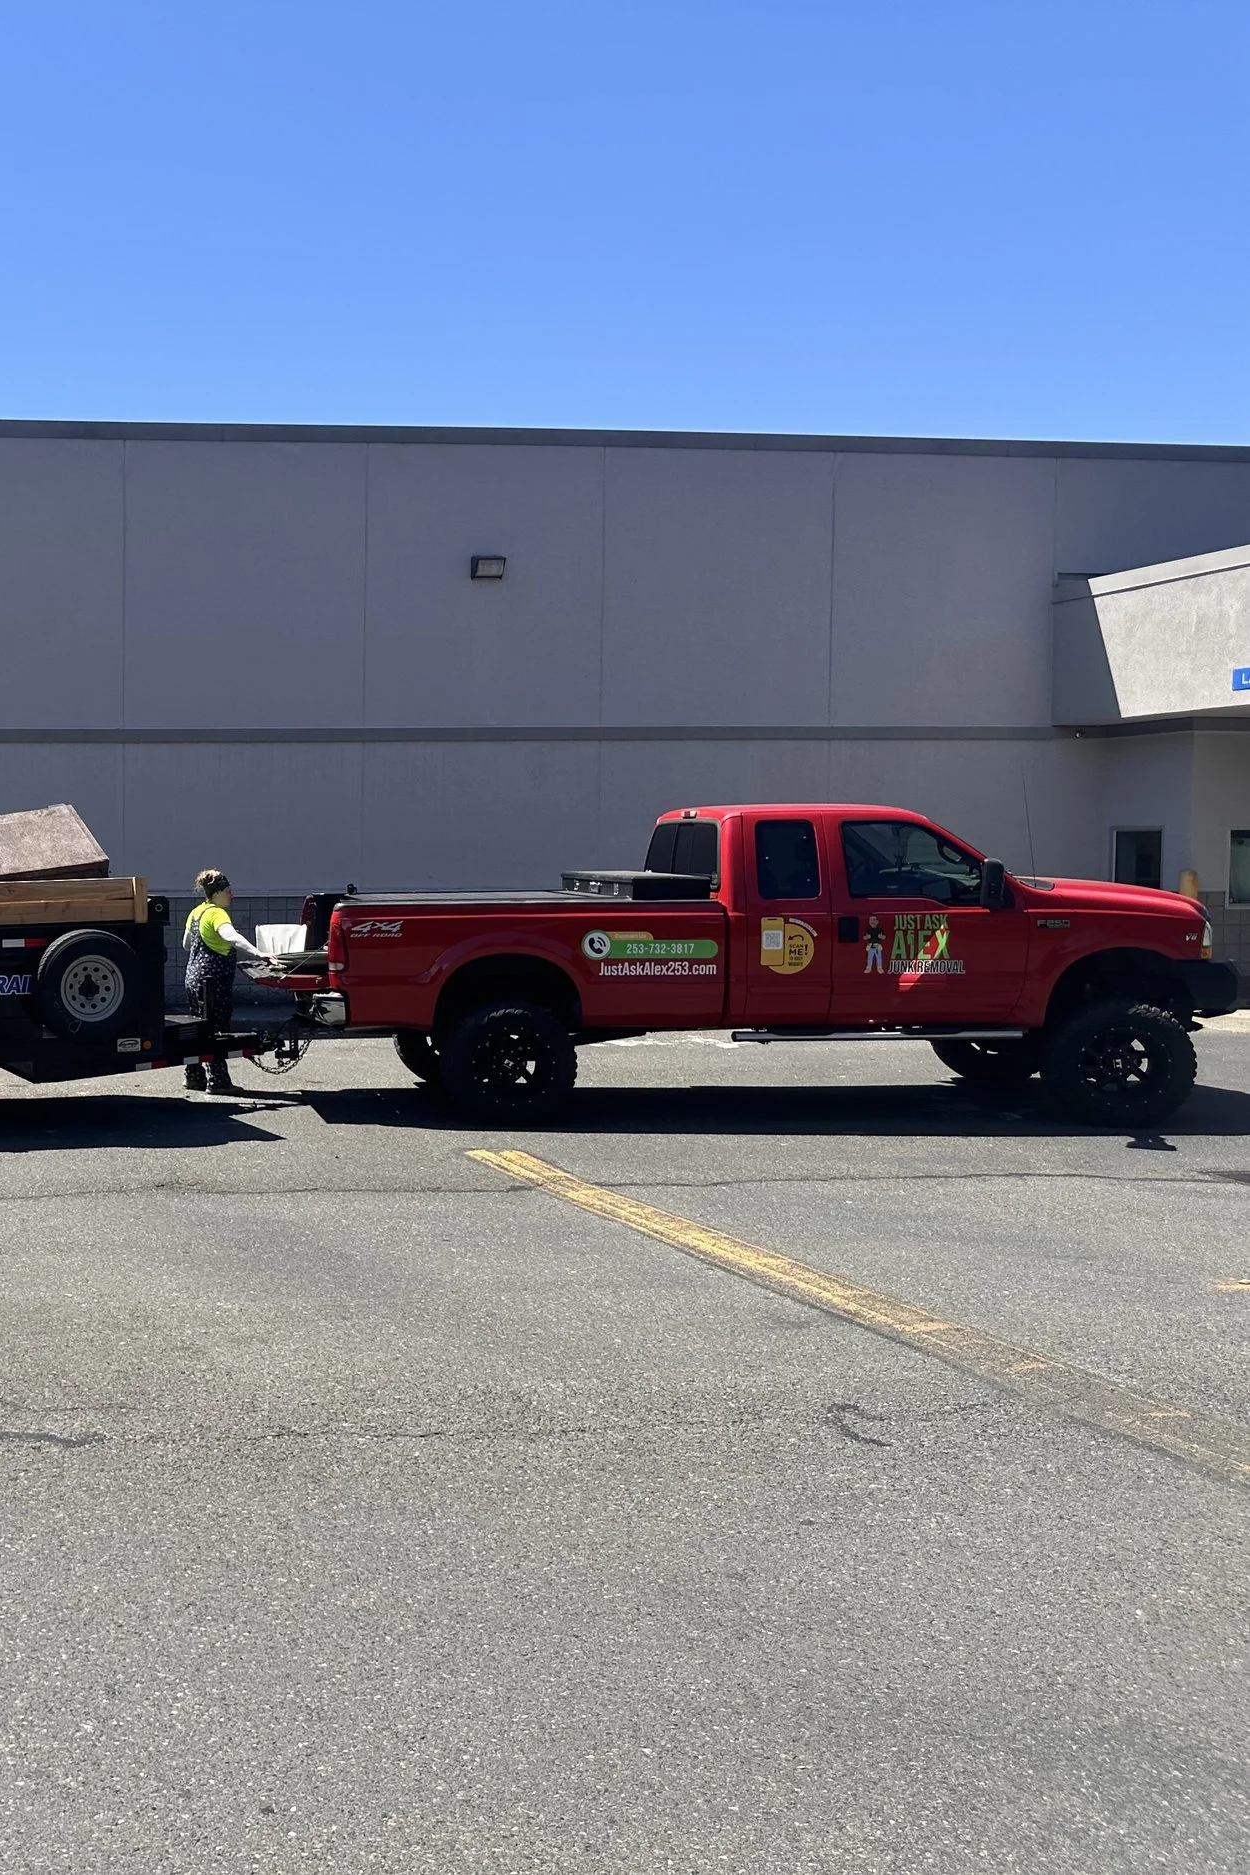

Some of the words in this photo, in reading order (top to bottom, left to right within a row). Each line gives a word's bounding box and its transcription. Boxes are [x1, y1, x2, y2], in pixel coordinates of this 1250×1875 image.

[894, 914, 921, 930] JUST
[924, 914, 949, 930] ASK
[626, 943, 694, 954] 253-732-3817
[599, 962, 717, 976] JustAskAlex253.com
[888, 960, 915, 974] JUNK
[916, 960, 966, 974] REMOVAL
